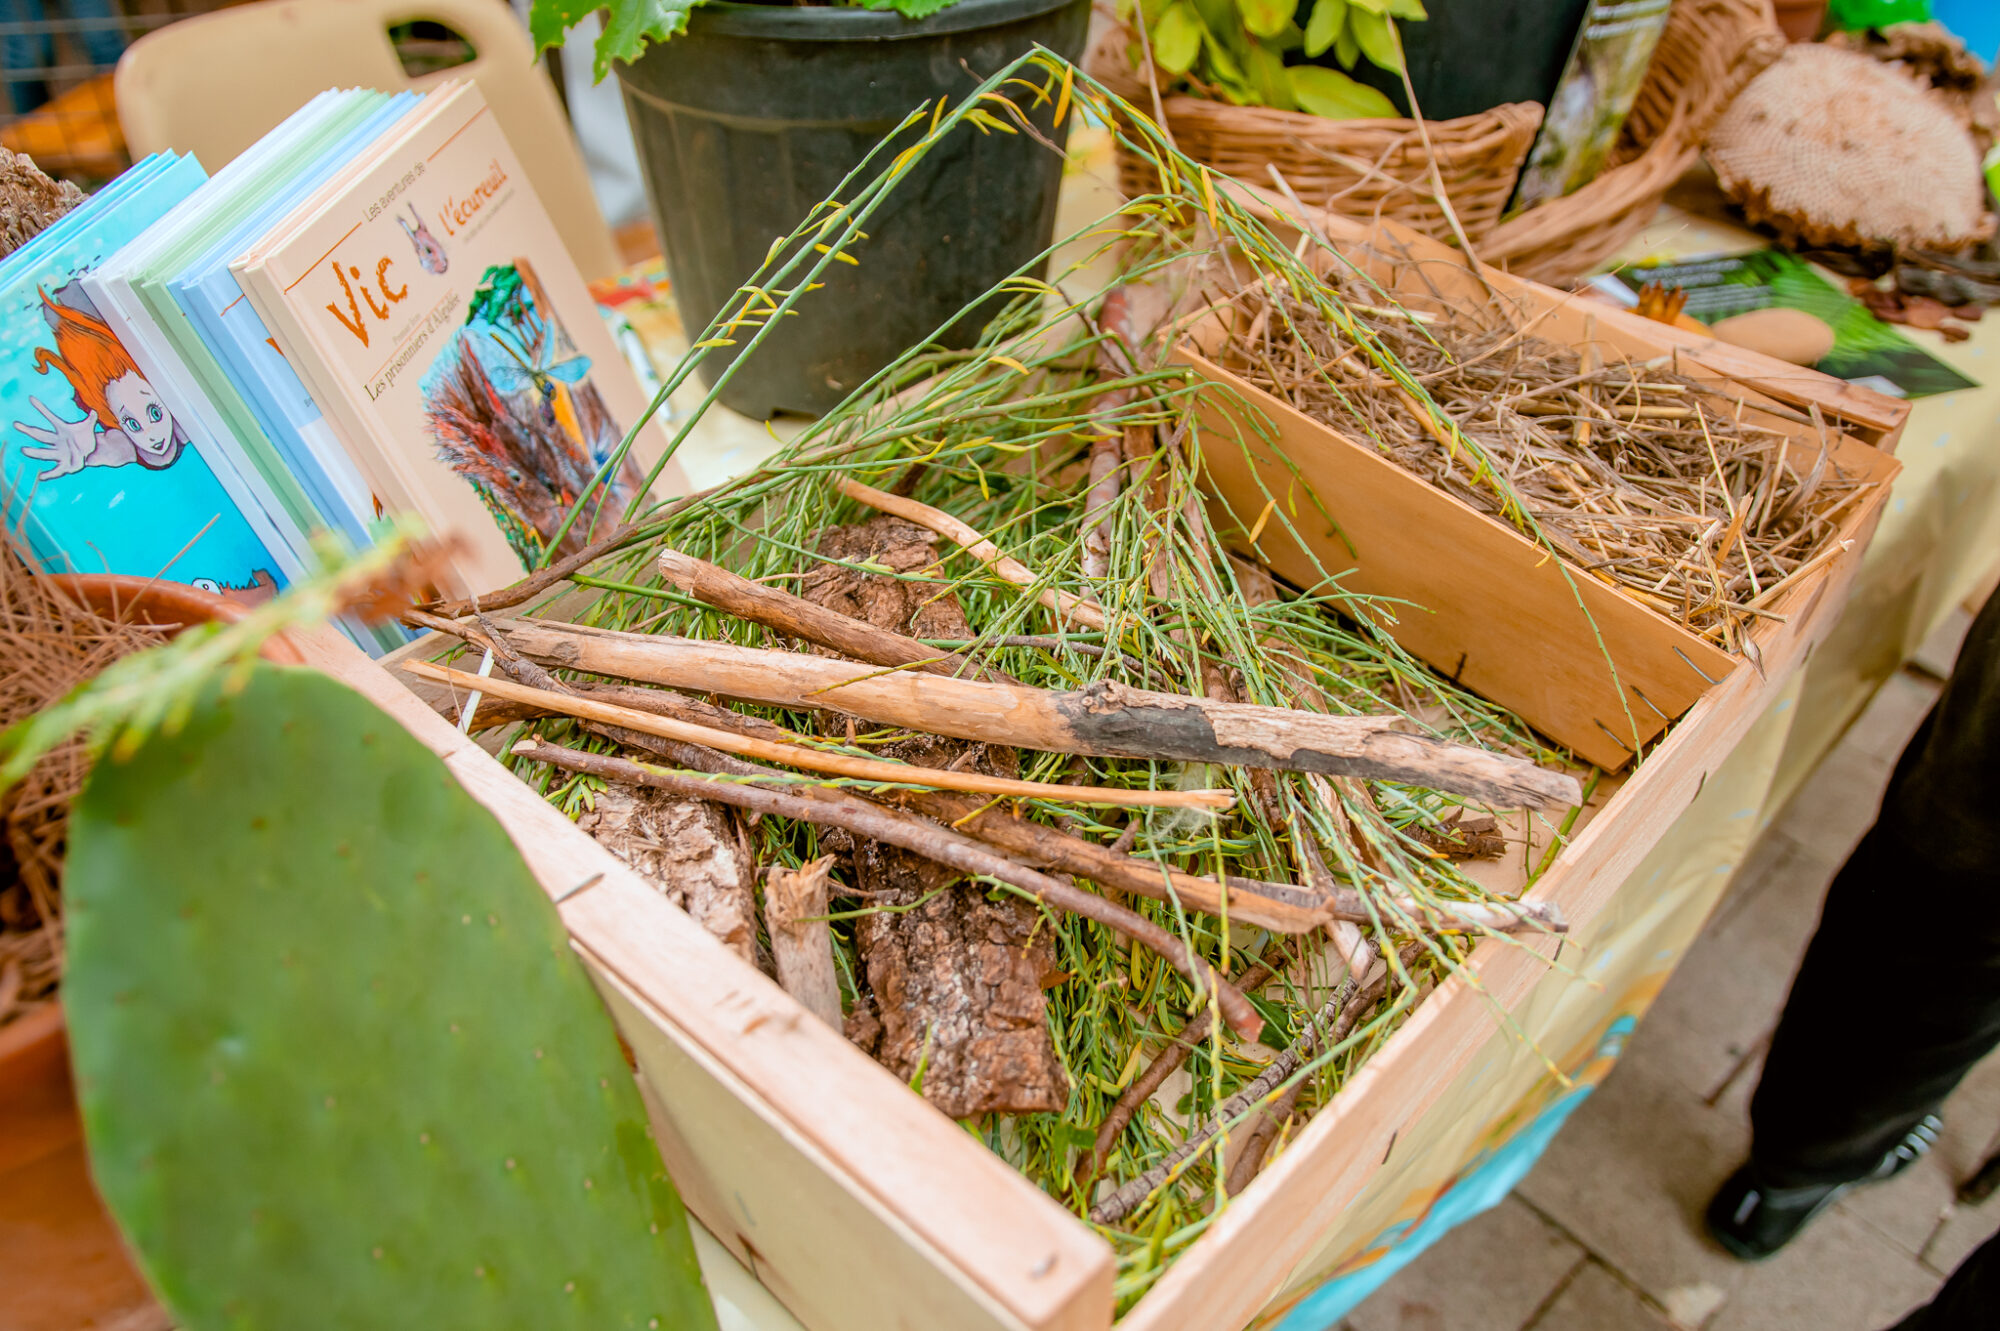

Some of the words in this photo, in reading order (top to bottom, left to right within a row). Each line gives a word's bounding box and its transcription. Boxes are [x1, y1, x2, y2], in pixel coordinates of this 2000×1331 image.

[362, 203, 382, 222] Les
[380, 171, 416, 209] aventures
[414, 161, 426, 177] de
[326, 256, 408, 348] Vic
[438, 158, 508, 237] l'écureuil
[363, 379, 387, 402] Les
[384, 331, 429, 388] prisonniers
